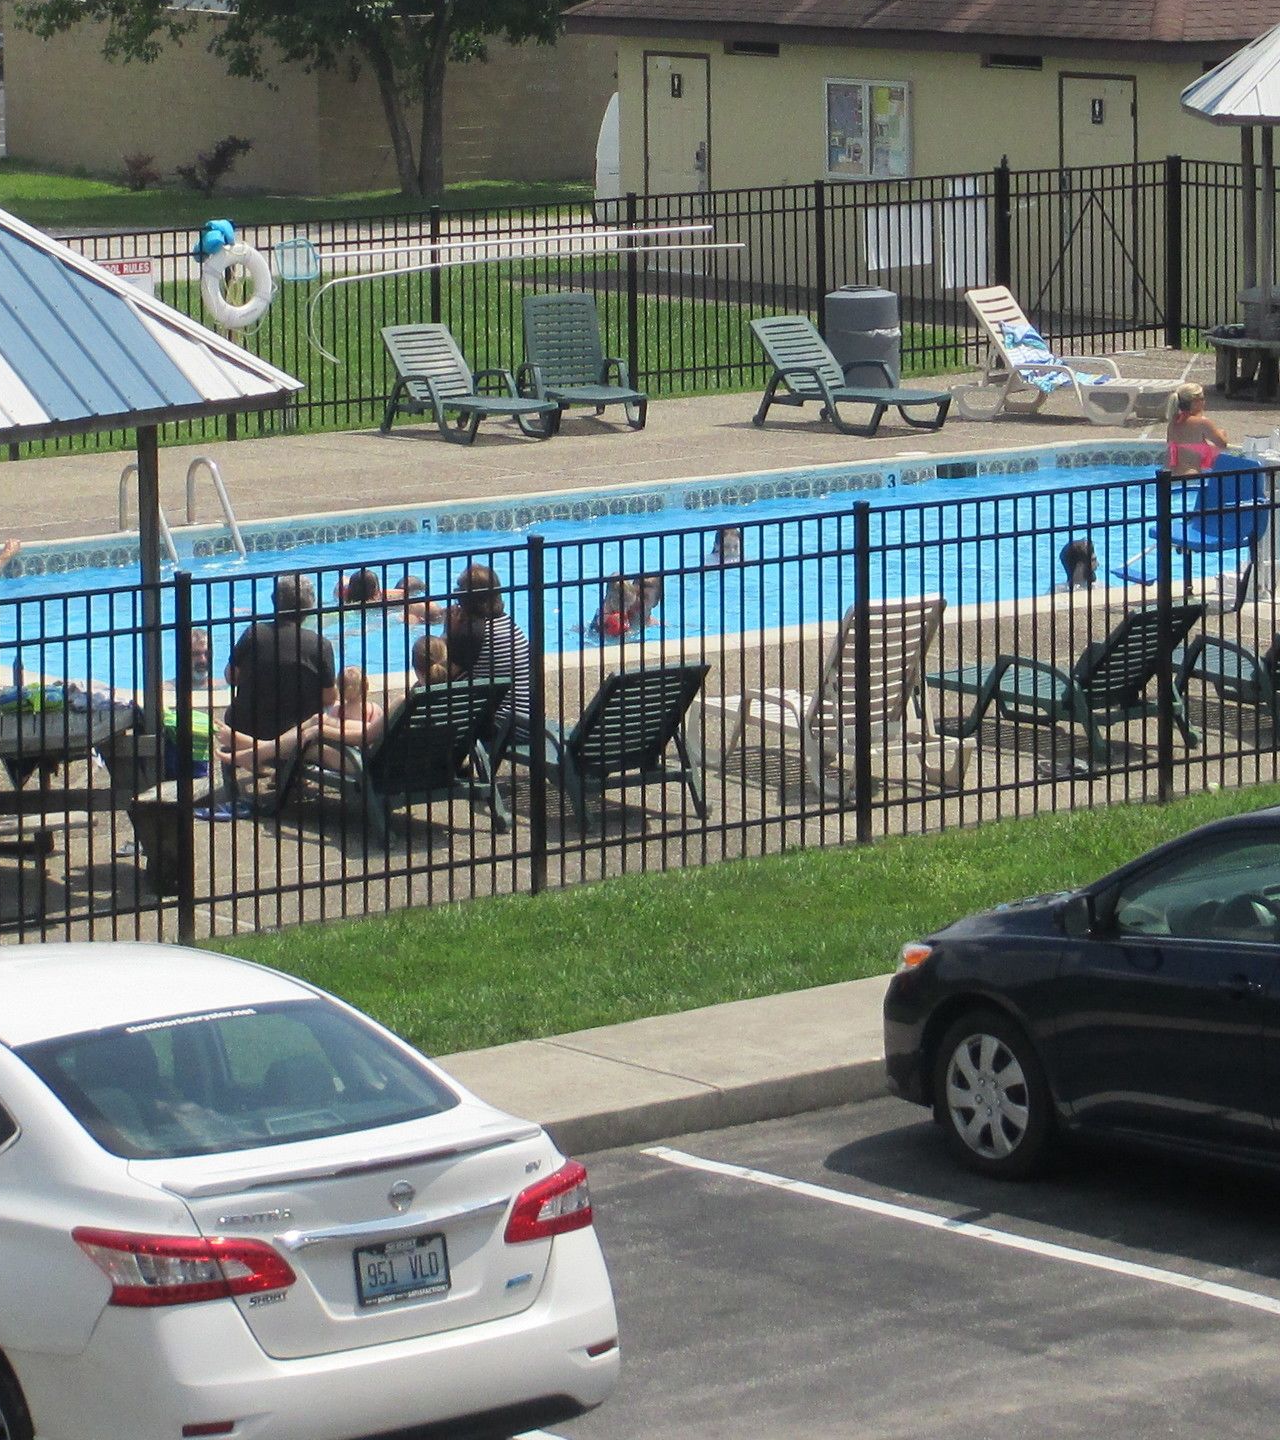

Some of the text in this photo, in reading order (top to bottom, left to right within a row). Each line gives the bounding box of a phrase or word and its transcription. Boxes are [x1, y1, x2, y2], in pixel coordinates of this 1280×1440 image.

[123, 262, 150, 273] RULES
[887, 473, 896, 488] 3
[422, 519, 432, 533] 5
[367, 1260, 398, 1289] 951
